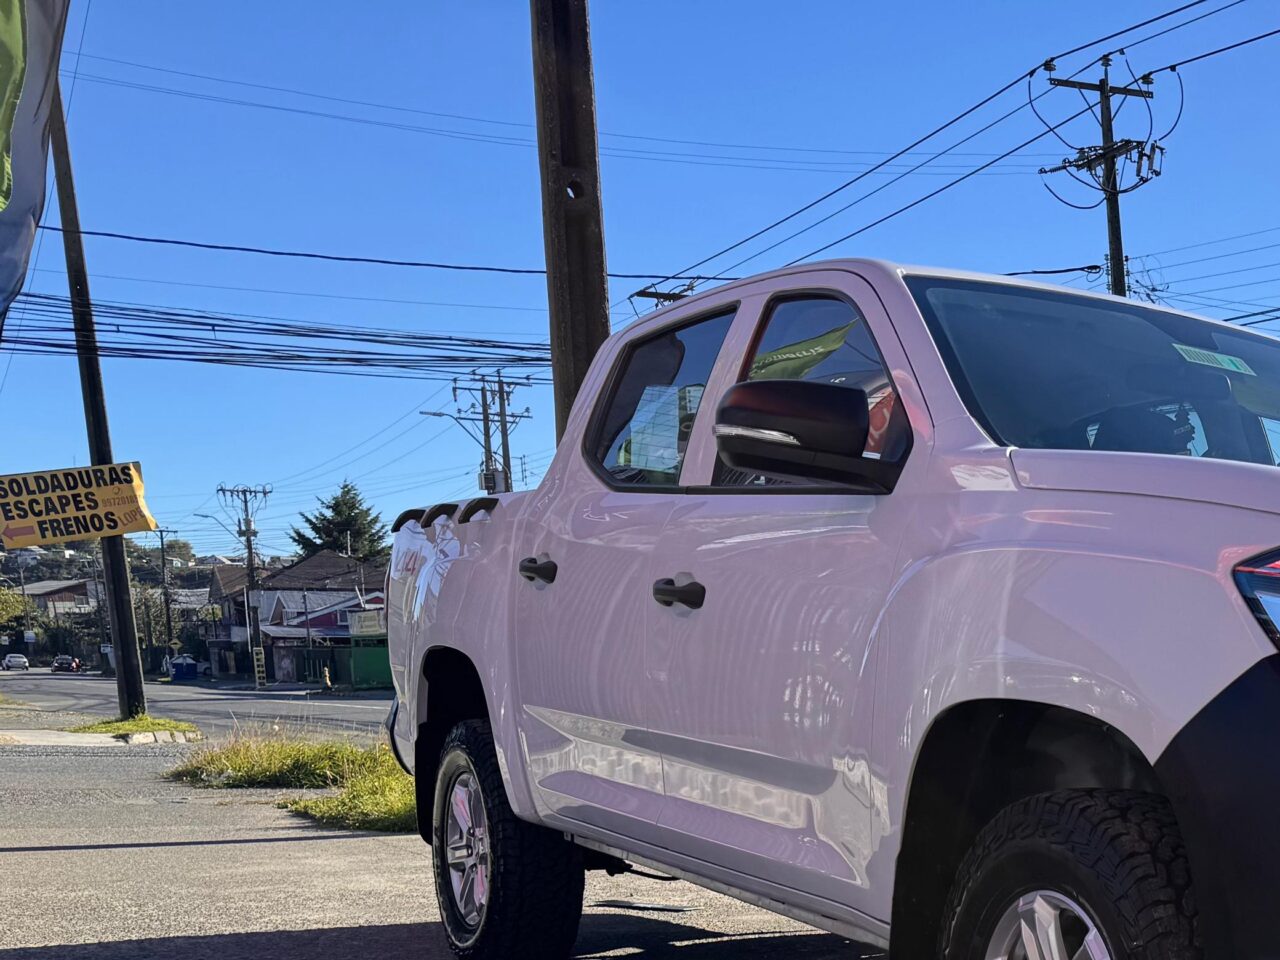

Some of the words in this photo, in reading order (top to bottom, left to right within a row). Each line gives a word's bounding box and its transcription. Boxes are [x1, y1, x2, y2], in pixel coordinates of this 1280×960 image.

[0, 465, 134, 499] SOLDADURAS
[0, 491, 98, 521] ESCAPES
[37, 511, 118, 539] FRENOS
